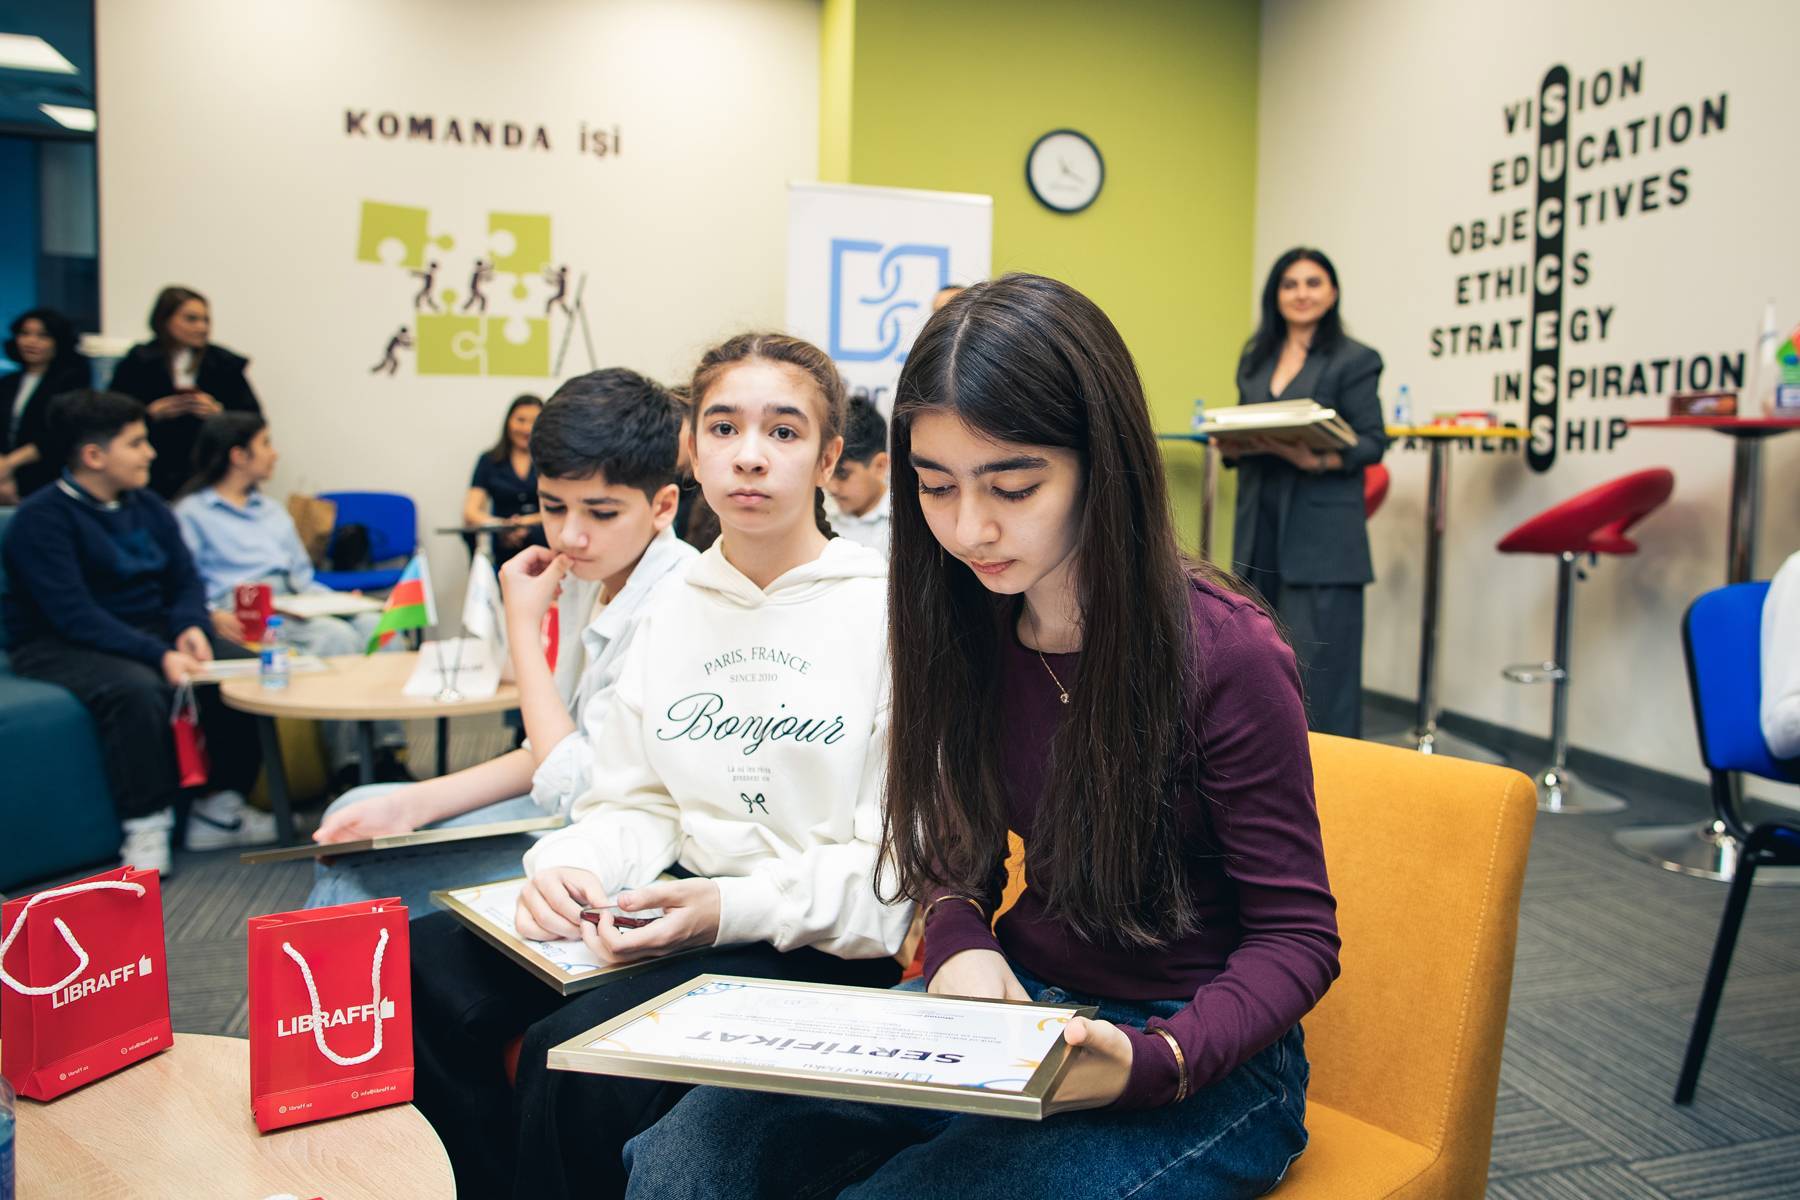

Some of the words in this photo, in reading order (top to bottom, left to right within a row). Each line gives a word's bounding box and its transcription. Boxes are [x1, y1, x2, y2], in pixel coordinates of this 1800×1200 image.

[1503, 58, 1644, 135] VISION
[344, 107, 551, 151] KOMANDA
[1489, 92, 1729, 193] EDUCATION
[1448, 166, 1690, 255] OBJECTIVES
[1455, 251, 1591, 306] ETHICS
[1429, 304, 1616, 358] STRATEGY
[1493, 351, 1746, 406] INSPIRATION
[703, 648, 747, 676] PARIS,
[751, 646, 812, 676] FRANCE
[729, 673, 757, 683] SINCE
[656, 692, 845, 756] Bonjour
[52, 963, 136, 1009] LIBRAFF
[277, 1003, 376, 1037] LIBRAFF
